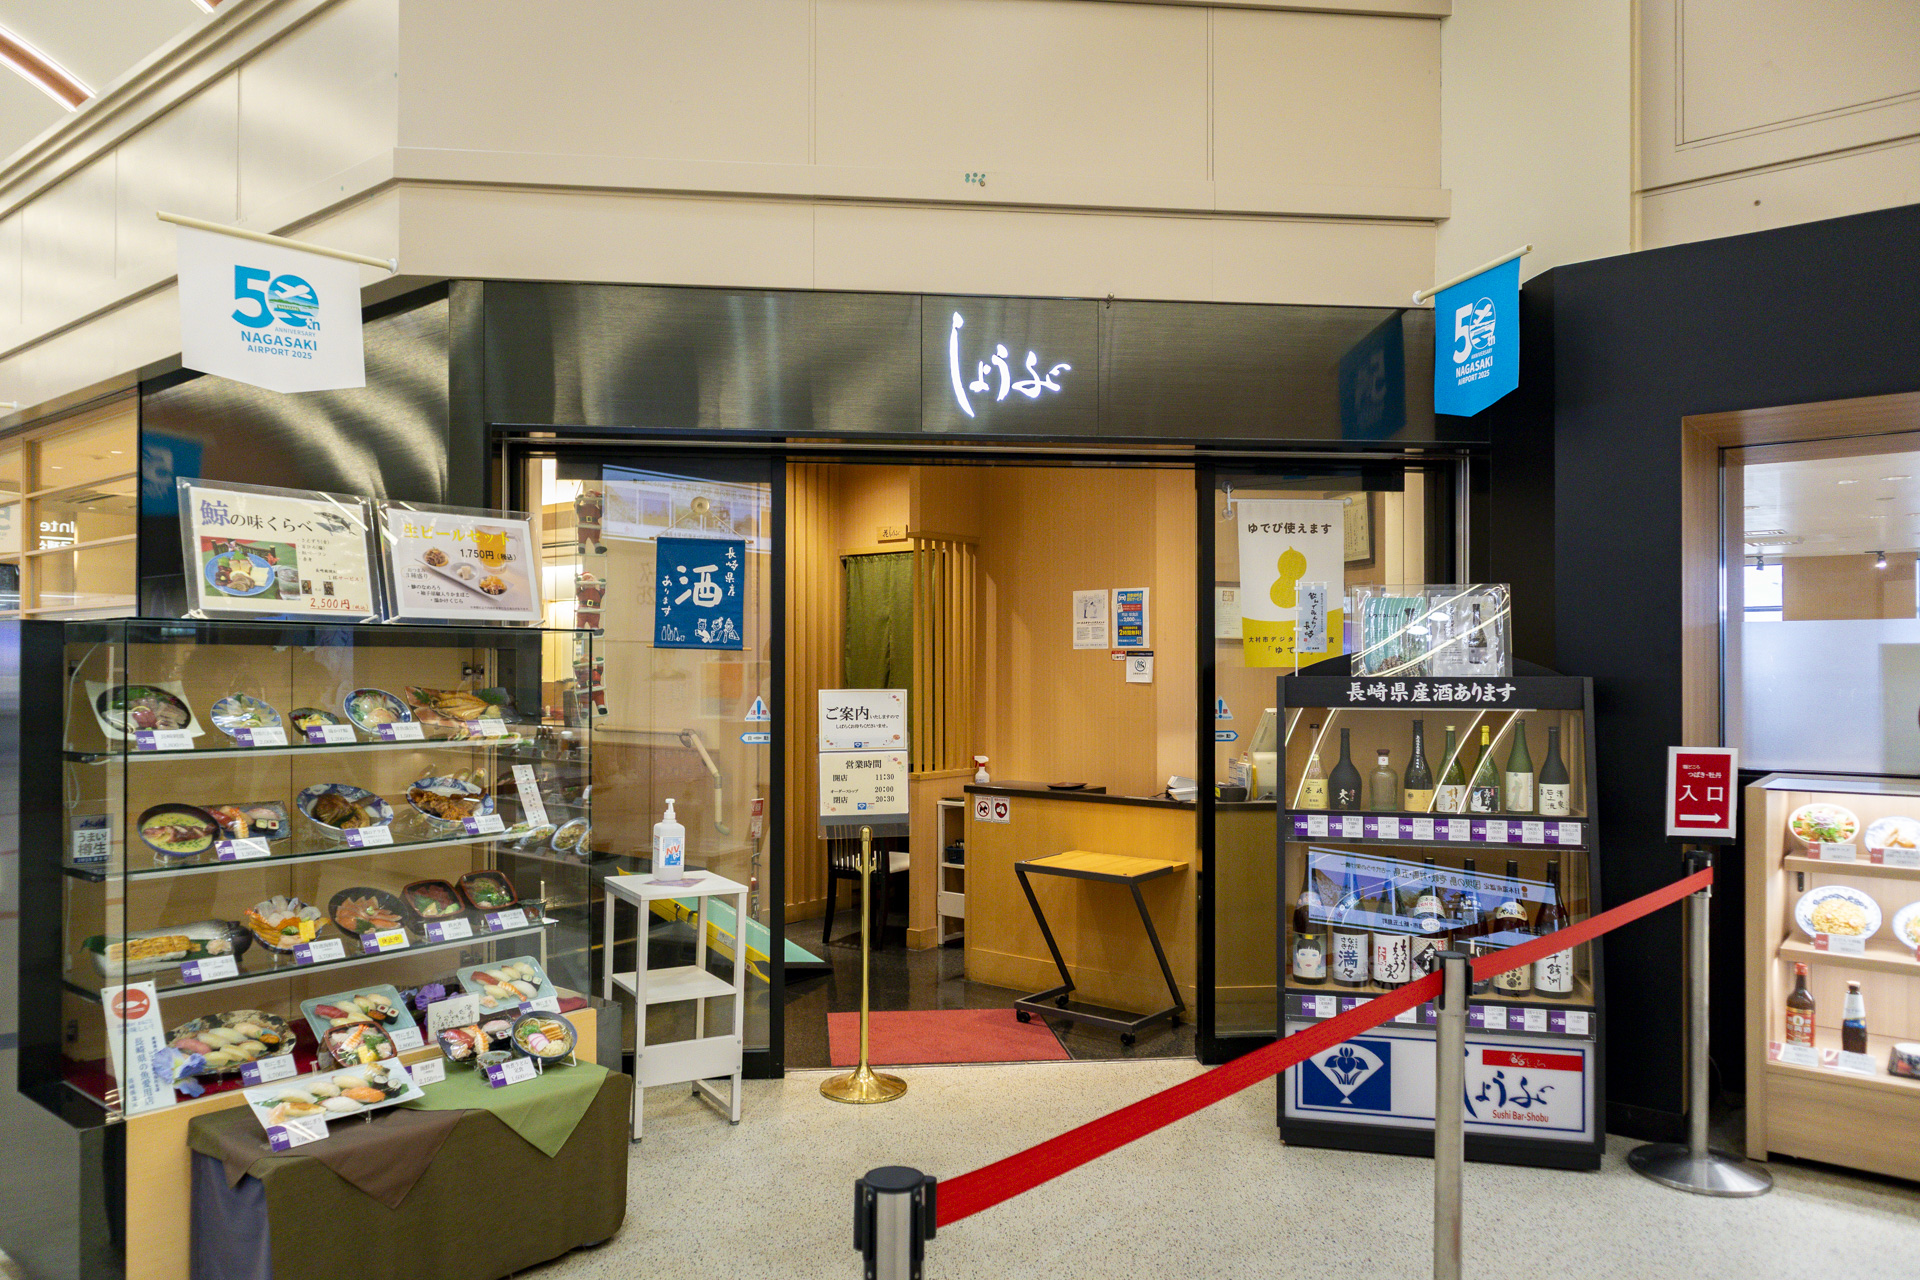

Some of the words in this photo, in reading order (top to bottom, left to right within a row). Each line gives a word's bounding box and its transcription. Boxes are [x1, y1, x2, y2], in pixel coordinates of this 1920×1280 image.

[241, 330, 317, 351] NAGASAKI
[274, 326, 316, 338] ANNIVERSARY
[247, 344, 289, 356] AIRPORT
[291, 350, 312, 360] 2025
[949, 311, 1072, 418] しょうぶ
[1455, 355, 1494, 378] NAGASAKI
[1457, 371, 1478, 386] AIRPORT
[1478, 369, 1490, 380] 2025
[200, 499, 314, 533] 鯨の味くらべ
[403, 522, 511, 546] 生ビールセット
[1248, 522, 1332, 535] ゆでび使えます
[460, 549, 494, 560] 1,750円
[674, 564, 723, 608] 酒
[661, 574, 672, 617] あります
[1346, 682, 1516, 702] 長崎県産酒あります
[845, 760, 882, 769] 営業時間
[832, 774, 848, 782] 開店
[875, 773, 894, 781] 11:30
[833, 796, 848, 804] 閉店
[875, 795, 895, 803] 20:30
[1678, 784, 1724, 802] 入口
[1492, 1109, 1511, 1120] Sushi
[1512, 1111, 1550, 1123] Bar-Shobu
